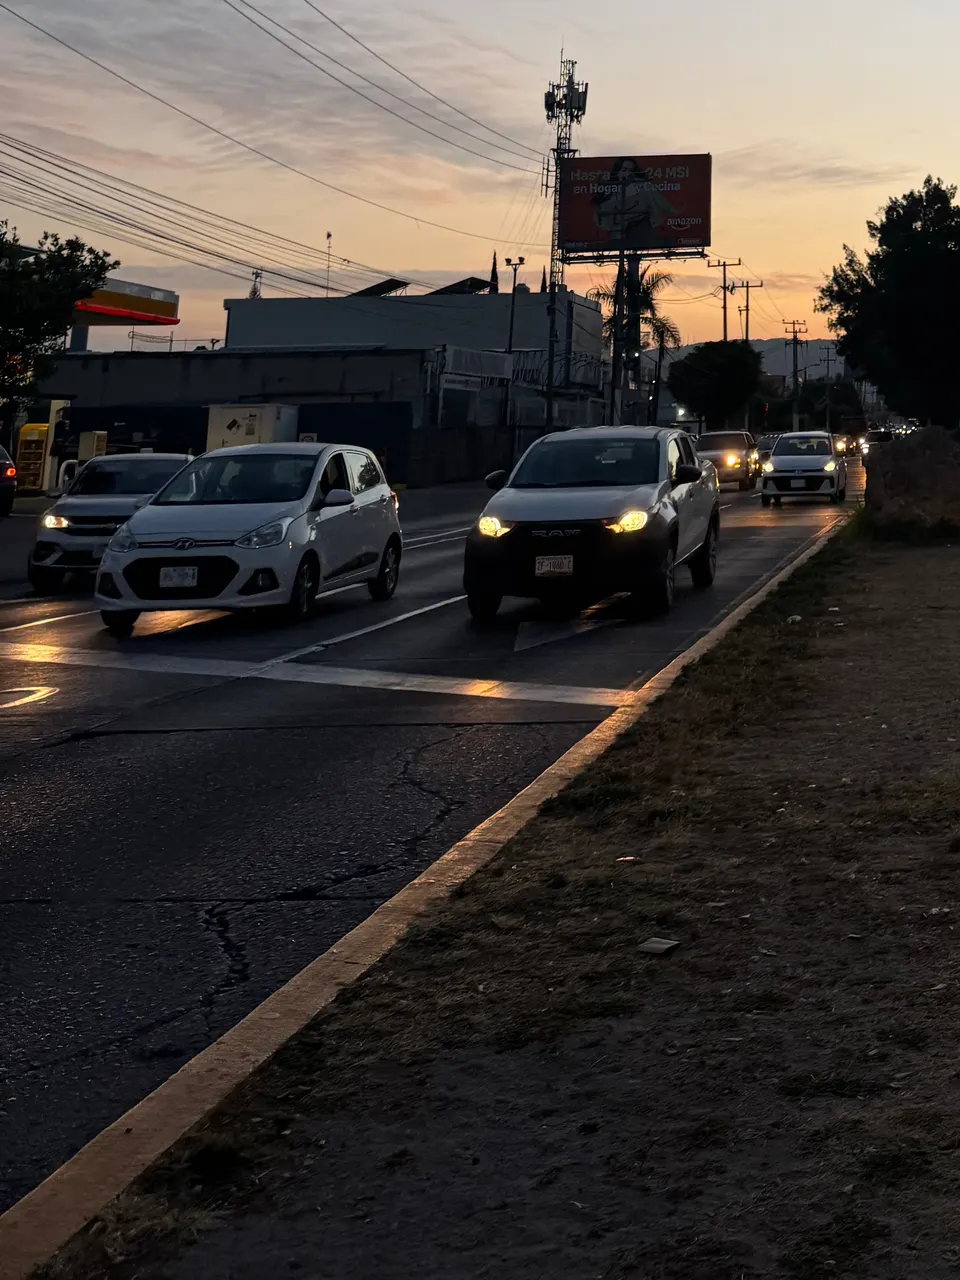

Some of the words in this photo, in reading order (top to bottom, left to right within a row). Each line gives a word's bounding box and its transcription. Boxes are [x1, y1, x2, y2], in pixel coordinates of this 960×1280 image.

[570, 169, 611, 181] Hasta
[665, 165, 690, 179] MSI
[574, 185, 587, 194] en
[590, 183, 622, 195] Hogar
[666, 217, 702, 226] amazon
